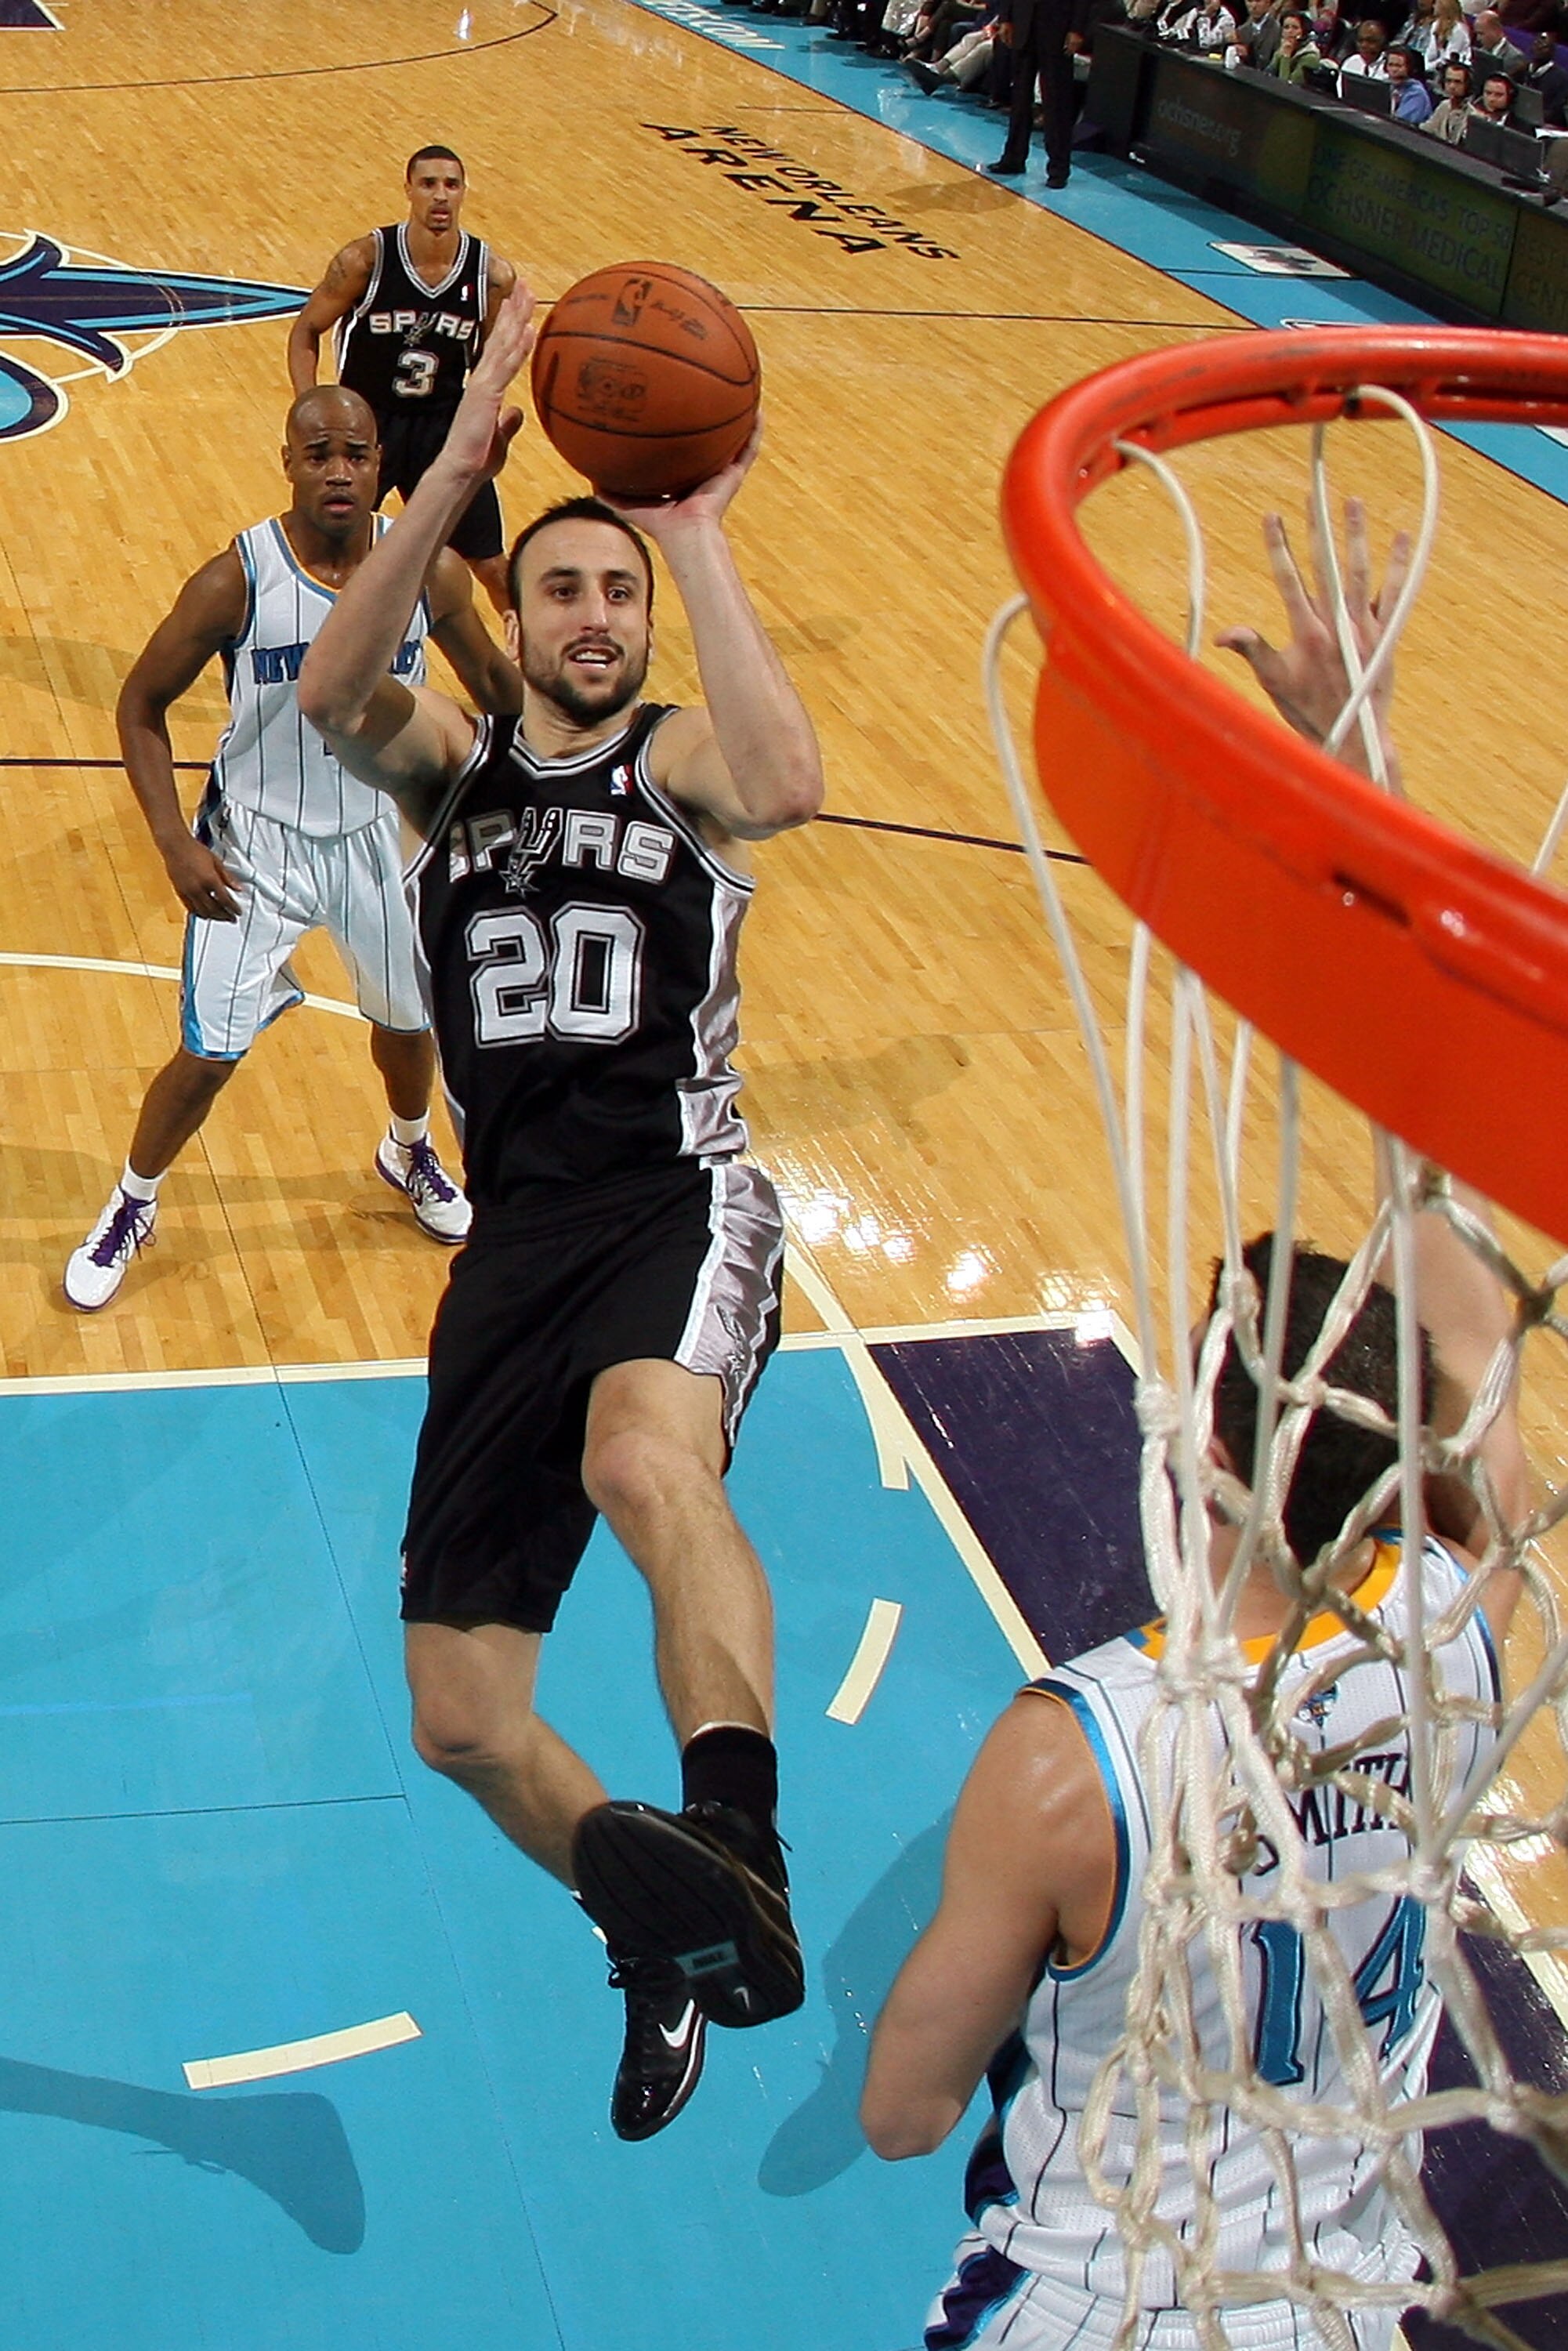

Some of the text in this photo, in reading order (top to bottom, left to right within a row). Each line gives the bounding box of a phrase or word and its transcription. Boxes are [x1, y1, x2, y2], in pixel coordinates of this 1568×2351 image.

[639, 123, 888, 255] ARENA
[702, 125, 961, 259] NEW ORLEANS
[1308, 174, 1404, 240] OCHSNER
[1410, 223, 1501, 291] MEDICAL
[368, 309, 476, 341] SPURS
[393, 350, 440, 398] 3
[464, 900, 646, 1049] 20
[1251, 1894, 1426, 2086] 14
